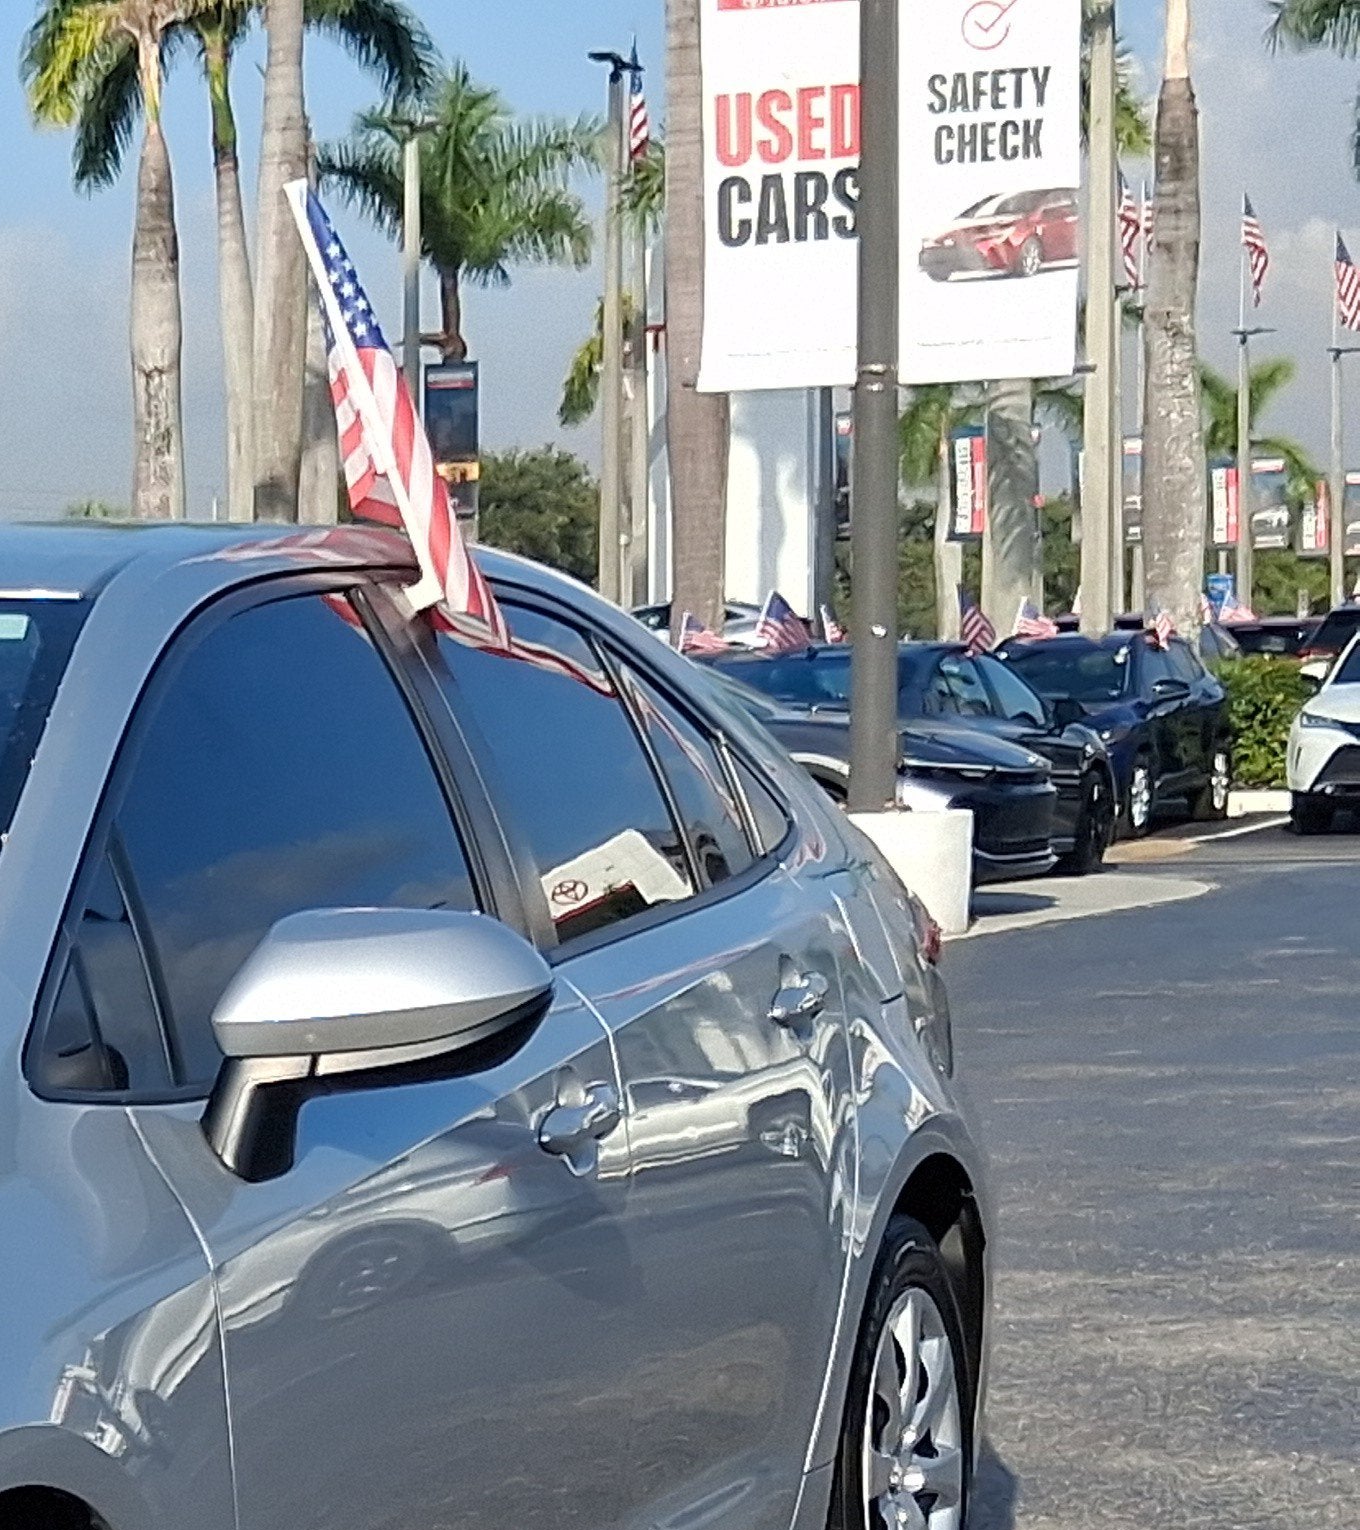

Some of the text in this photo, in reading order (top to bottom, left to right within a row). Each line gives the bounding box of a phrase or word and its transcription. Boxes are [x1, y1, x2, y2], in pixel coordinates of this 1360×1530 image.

[926, 66, 1051, 115] SAFETY
[714, 83, 861, 167] USED
[934, 118, 1044, 166] CHECK
[717, 166, 861, 248] CARS
